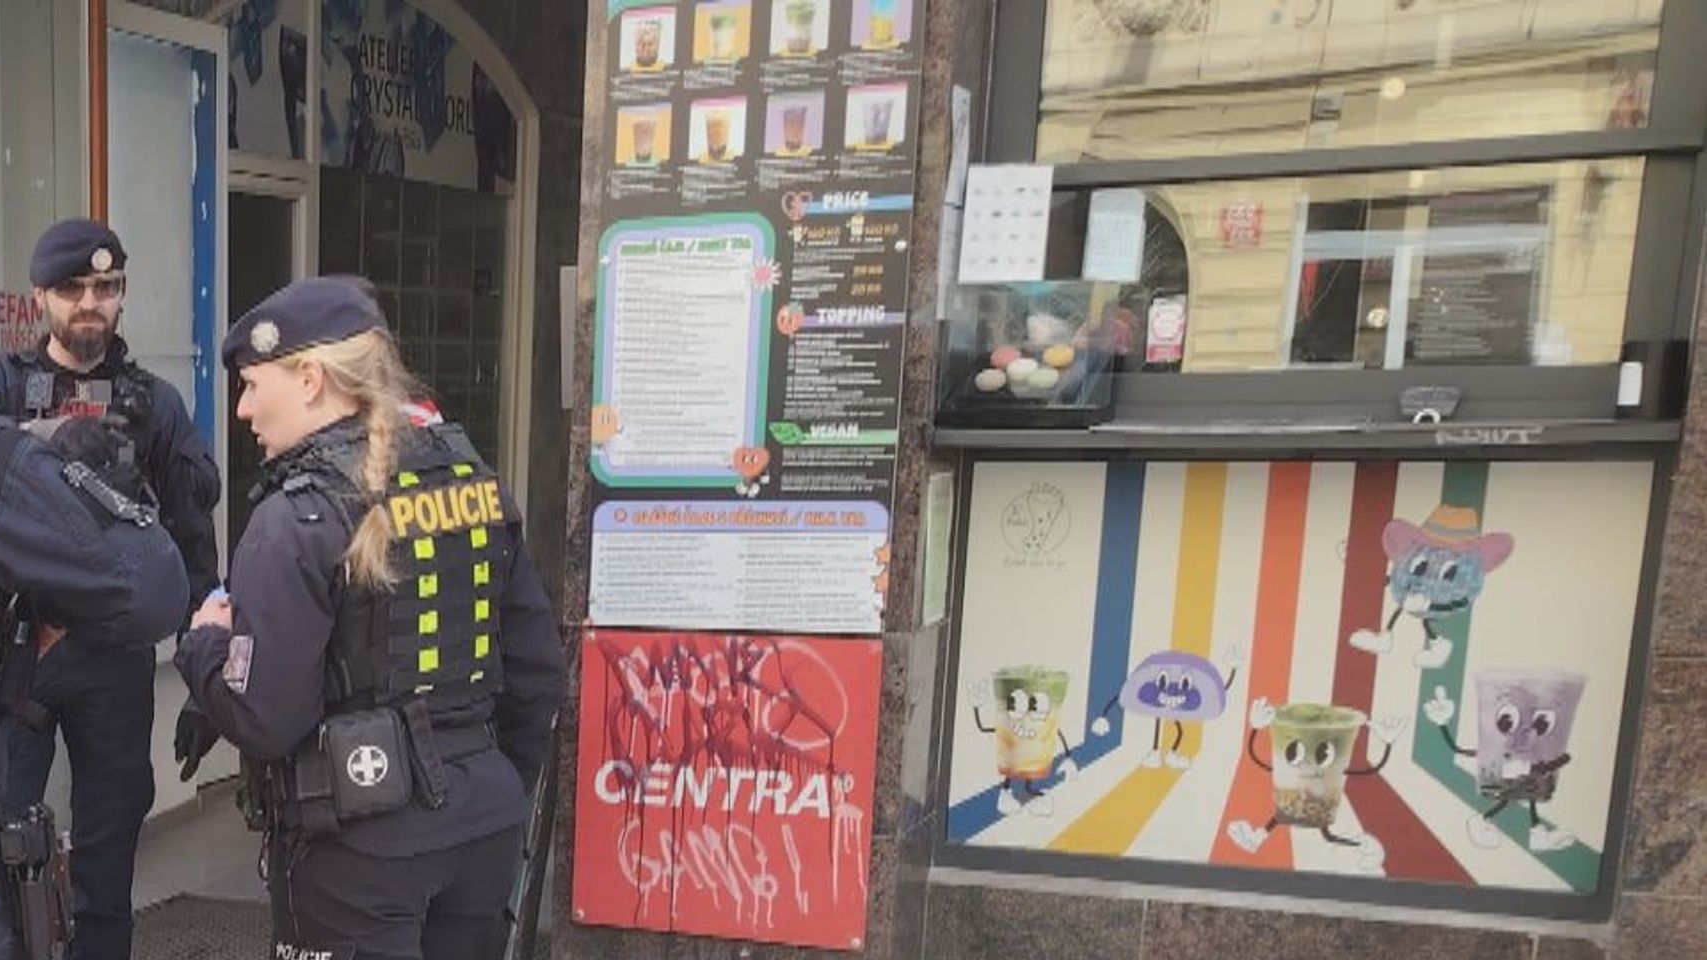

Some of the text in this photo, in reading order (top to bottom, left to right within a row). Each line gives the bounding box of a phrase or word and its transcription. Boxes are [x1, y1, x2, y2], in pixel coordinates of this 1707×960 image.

[816, 305, 886, 324] TOPPING
[810, 422, 860, 439] VEGAN
[390, 480, 504, 538] POLICIE
